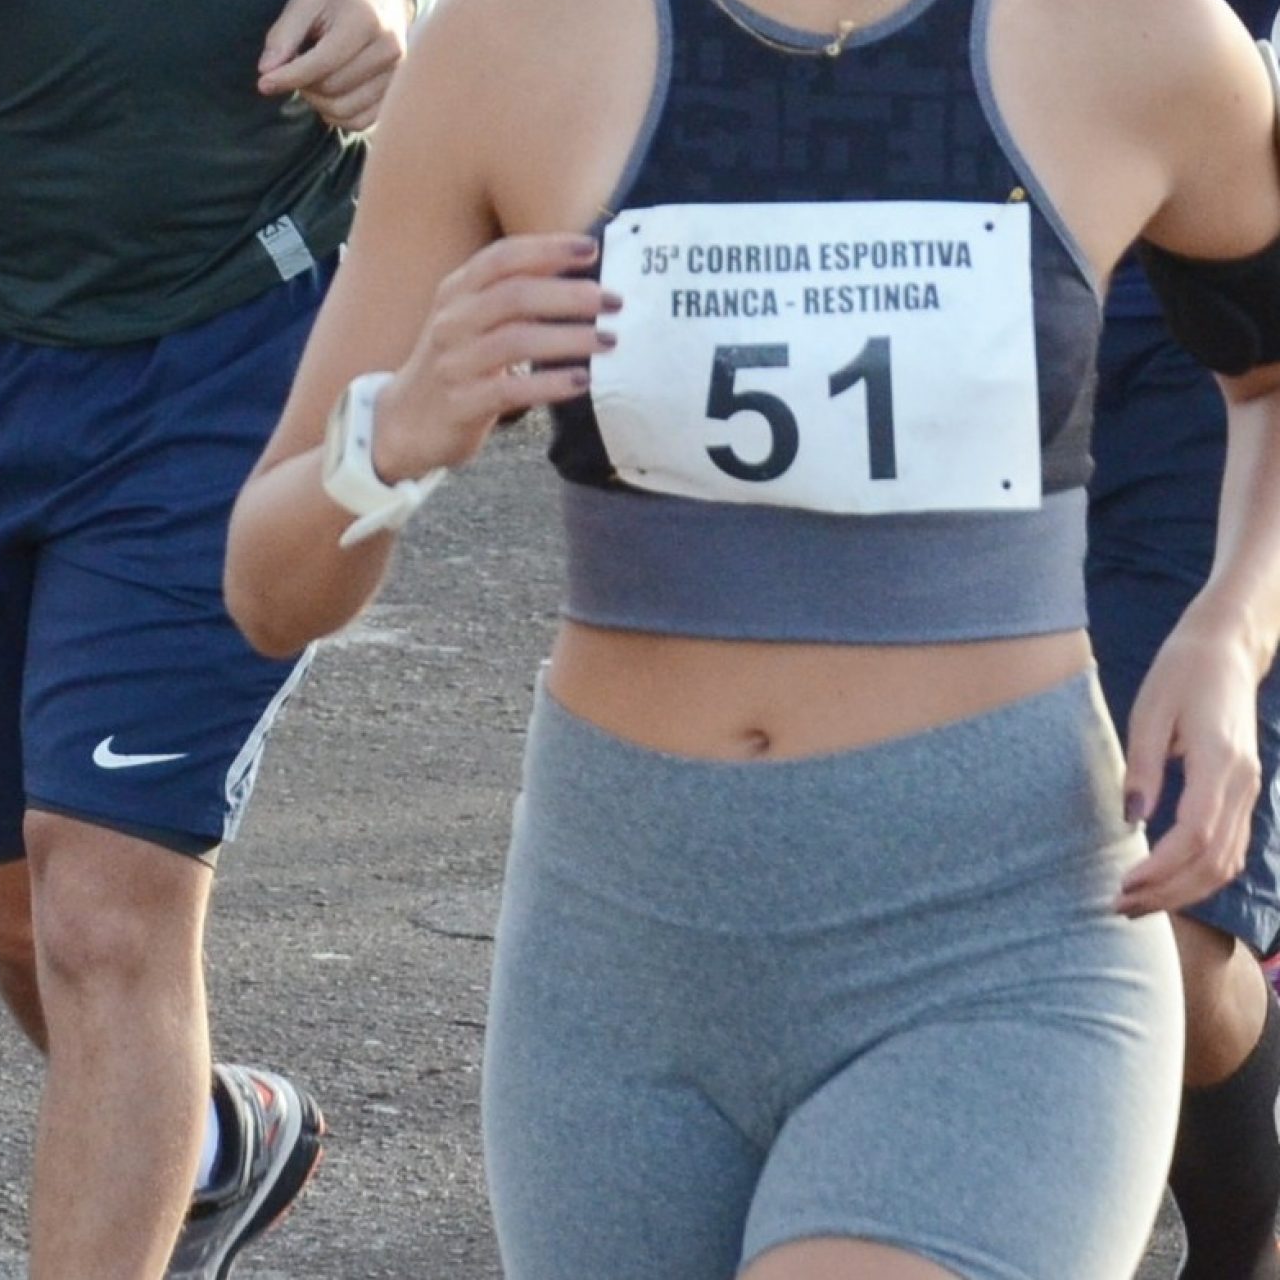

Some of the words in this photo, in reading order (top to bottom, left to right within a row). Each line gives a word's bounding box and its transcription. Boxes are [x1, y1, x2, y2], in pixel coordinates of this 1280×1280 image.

[687, 243, 811, 273] CORRIDA
[819, 240, 972, 271] ESPORTIVA
[671, 288, 778, 318] FRANCA
[803, 283, 940, 315] RESTINGA
[704, 335, 898, 483] 51
